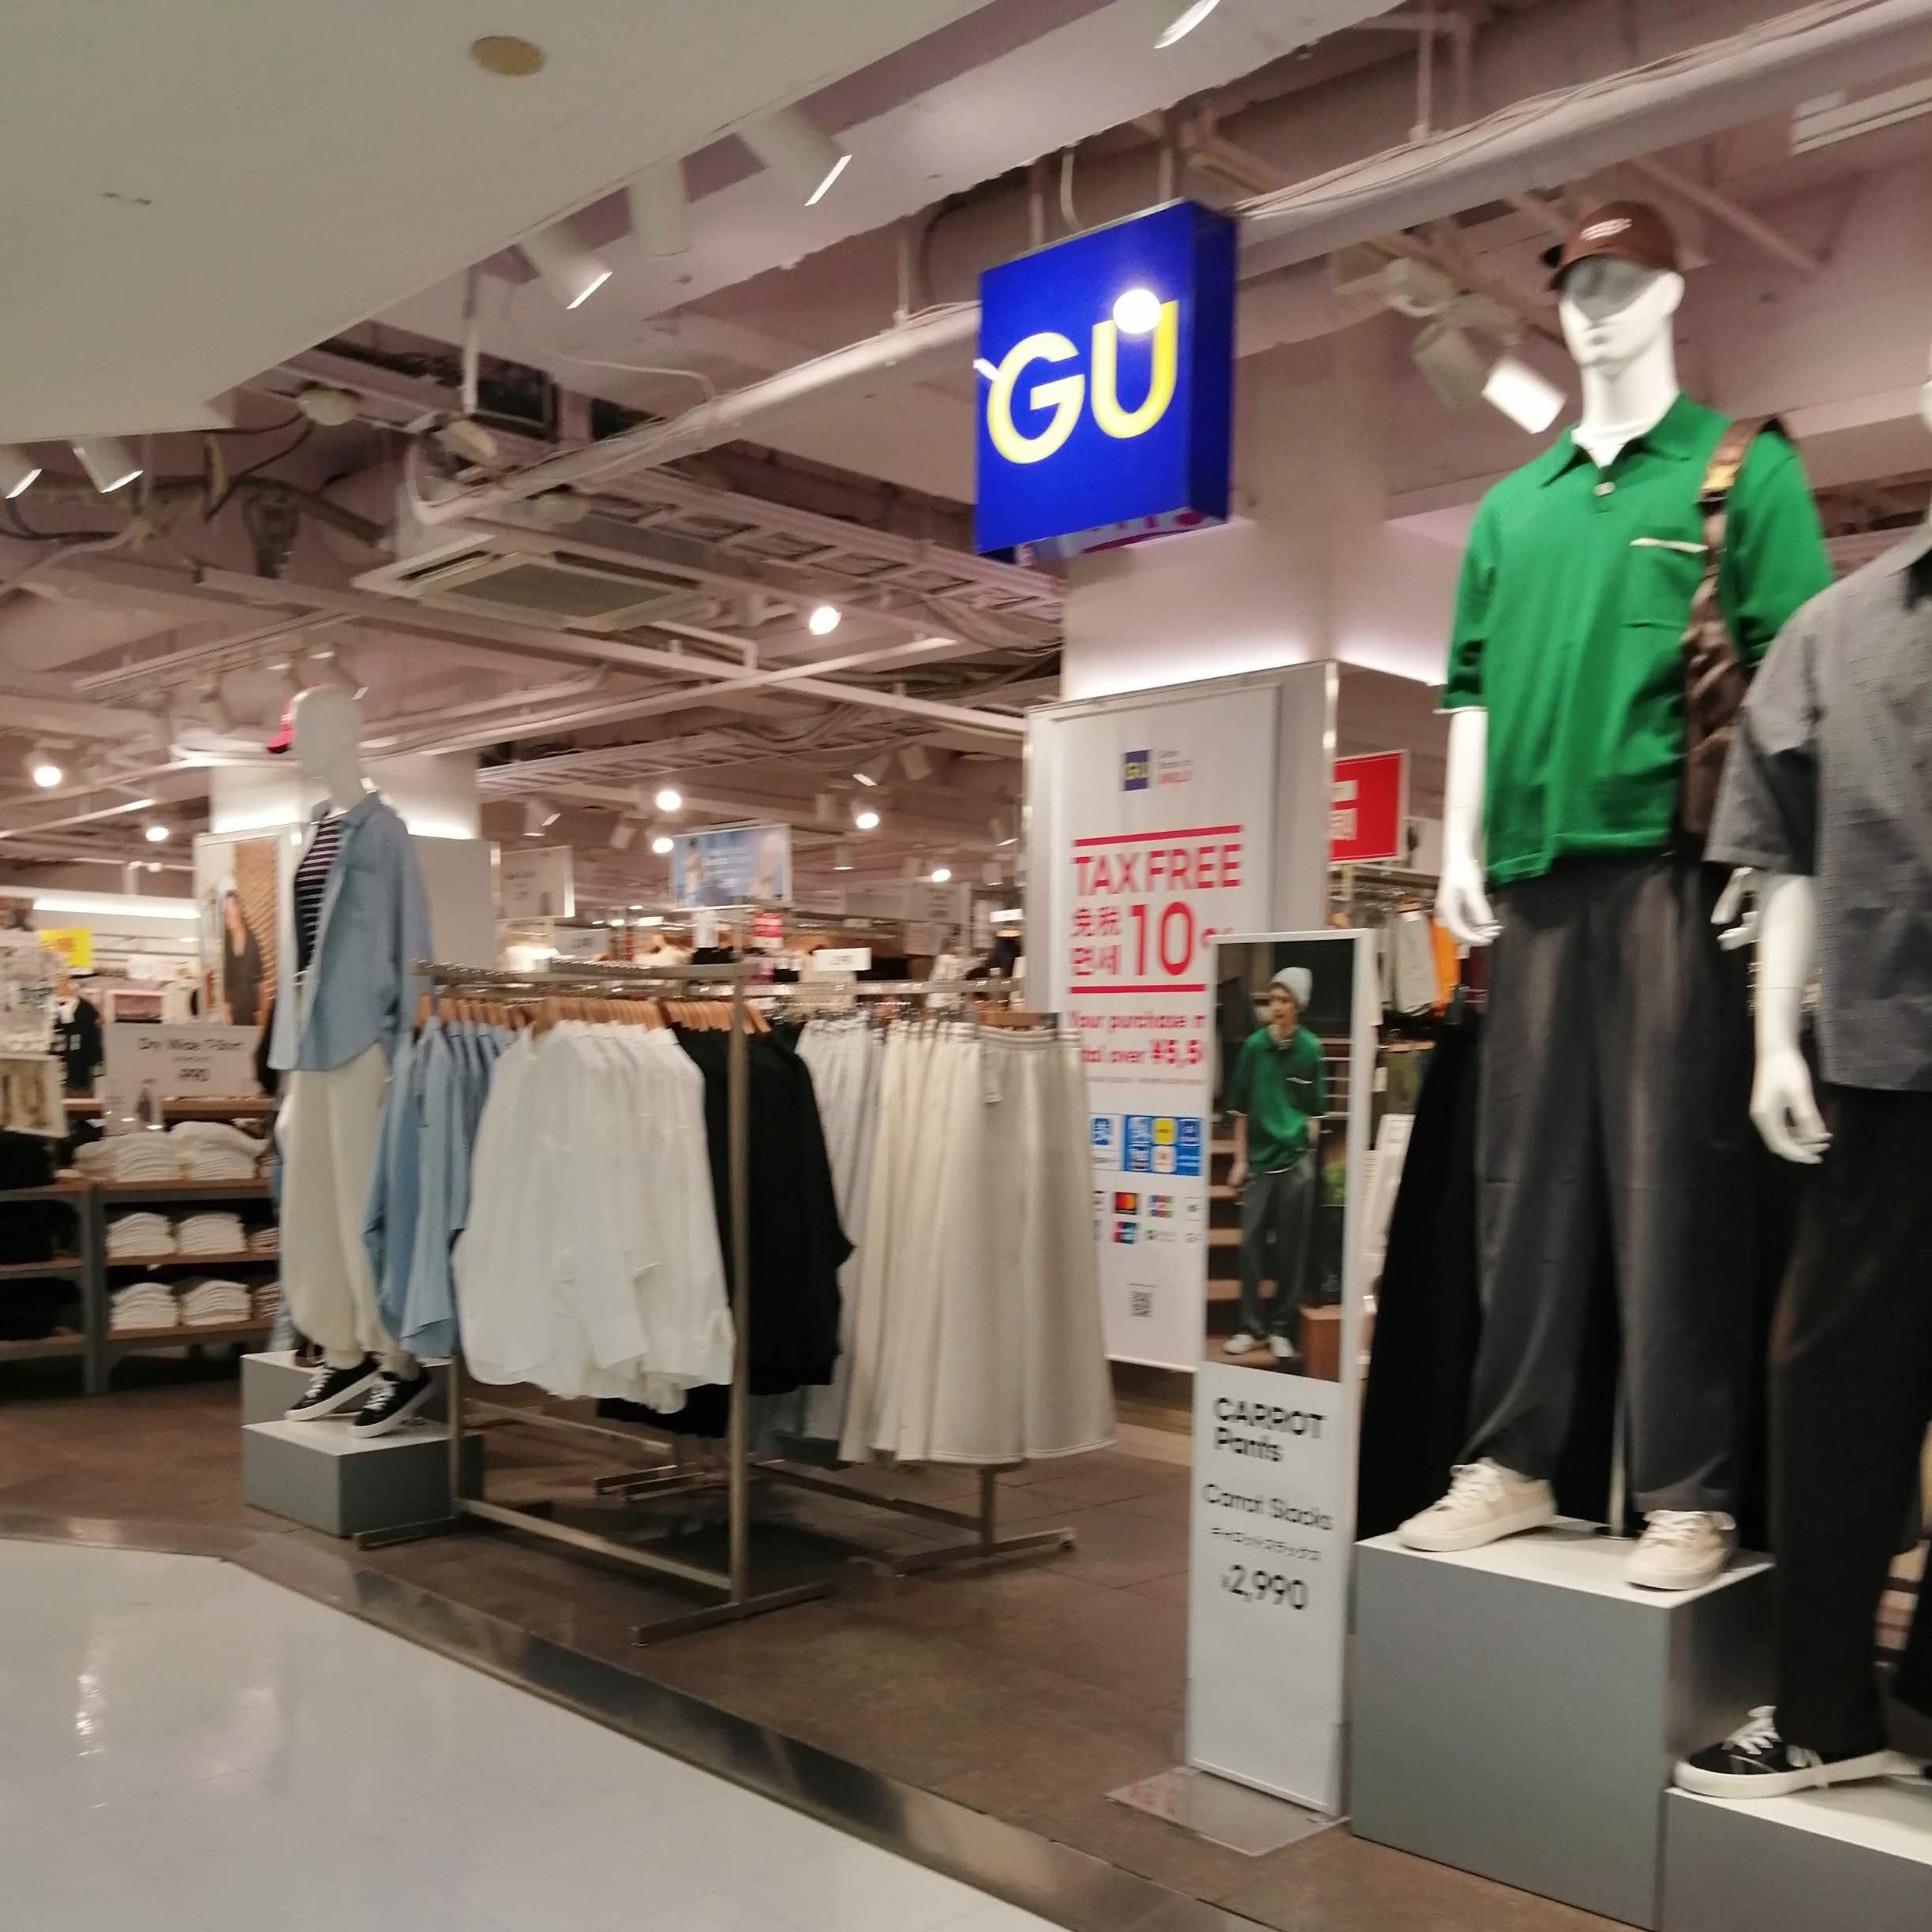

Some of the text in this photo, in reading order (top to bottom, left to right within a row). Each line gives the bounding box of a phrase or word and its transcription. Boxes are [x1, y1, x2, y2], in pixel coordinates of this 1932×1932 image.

[987, 300, 1179, 464] GU
[1073, 844, 1243, 897] TAX FREE
[1130, 901, 1234, 976] 10
[1108, 1010, 1187, 1034] purchase
[1214, 1397, 1329, 1439] CARROT
[1214, 1426, 1283, 1462] Pants
